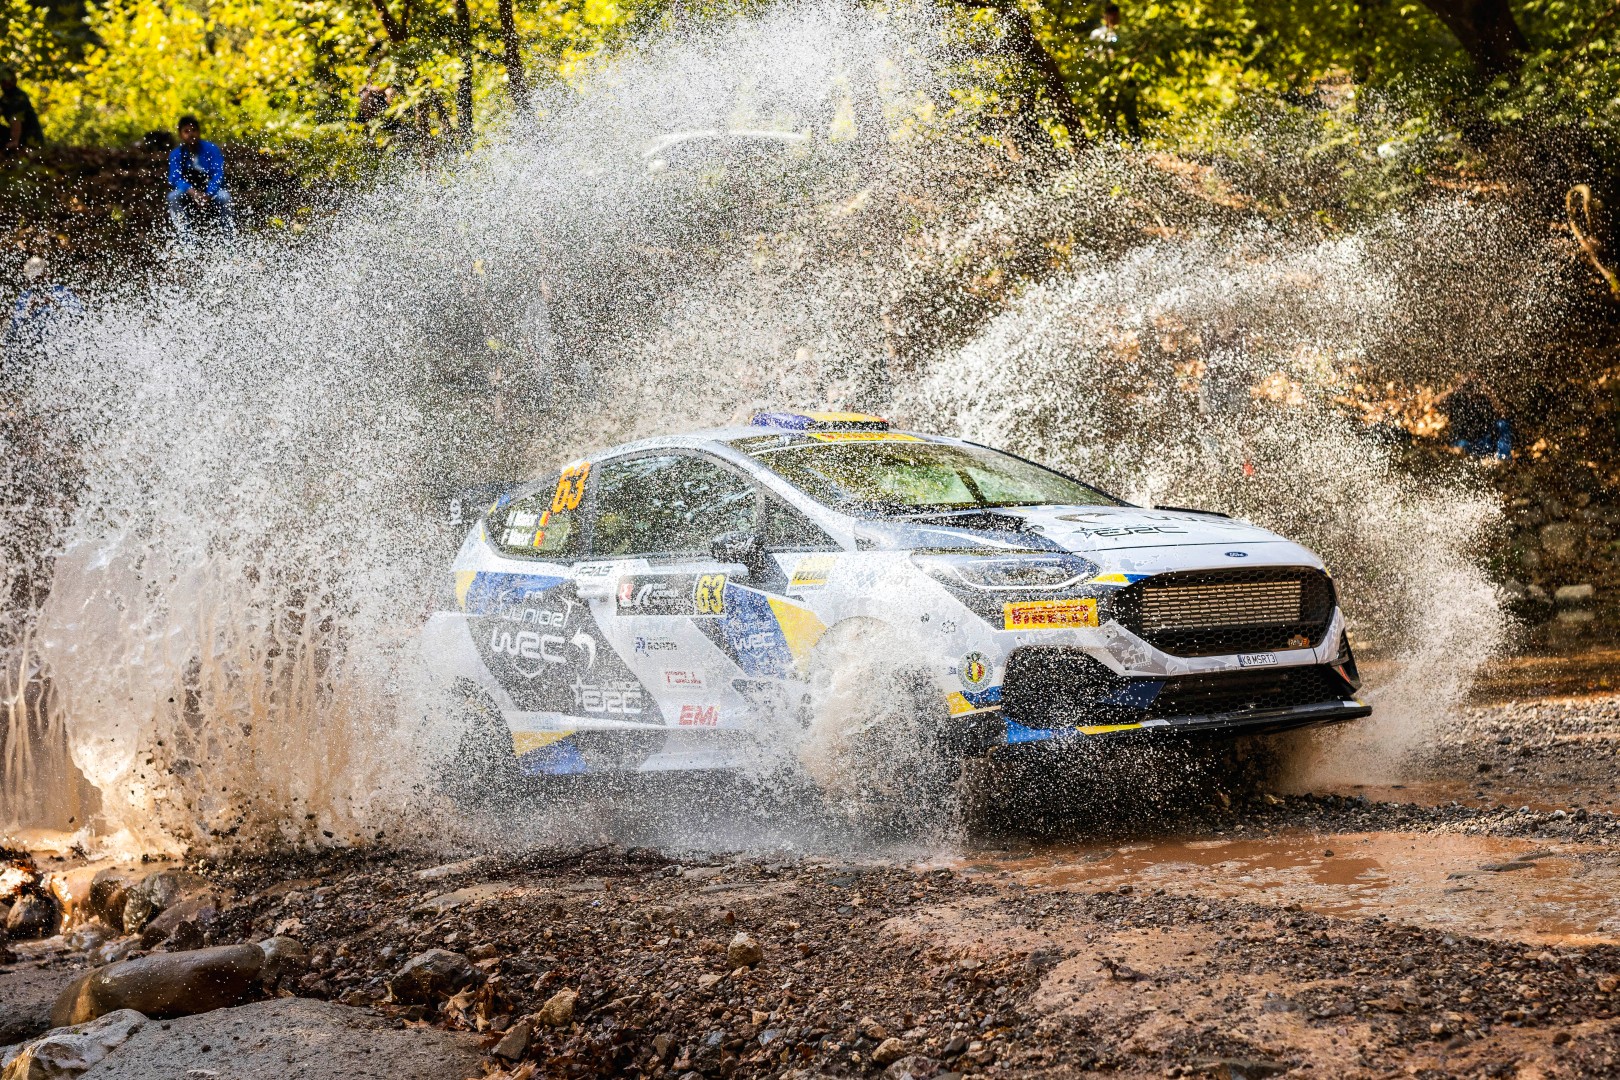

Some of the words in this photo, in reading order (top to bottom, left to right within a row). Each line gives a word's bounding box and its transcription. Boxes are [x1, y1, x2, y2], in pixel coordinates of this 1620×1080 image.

[552, 462, 591, 513] 63
[696, 574, 726, 614] 63
[500, 604, 565, 629] JUNIOR
[1012, 604, 1090, 625] PIRELLI
[490, 626, 568, 664] WRC
[732, 631, 776, 650] WRC
[1242, 656, 1252, 665] K8
[1252, 654, 1277, 665] MSRT3
